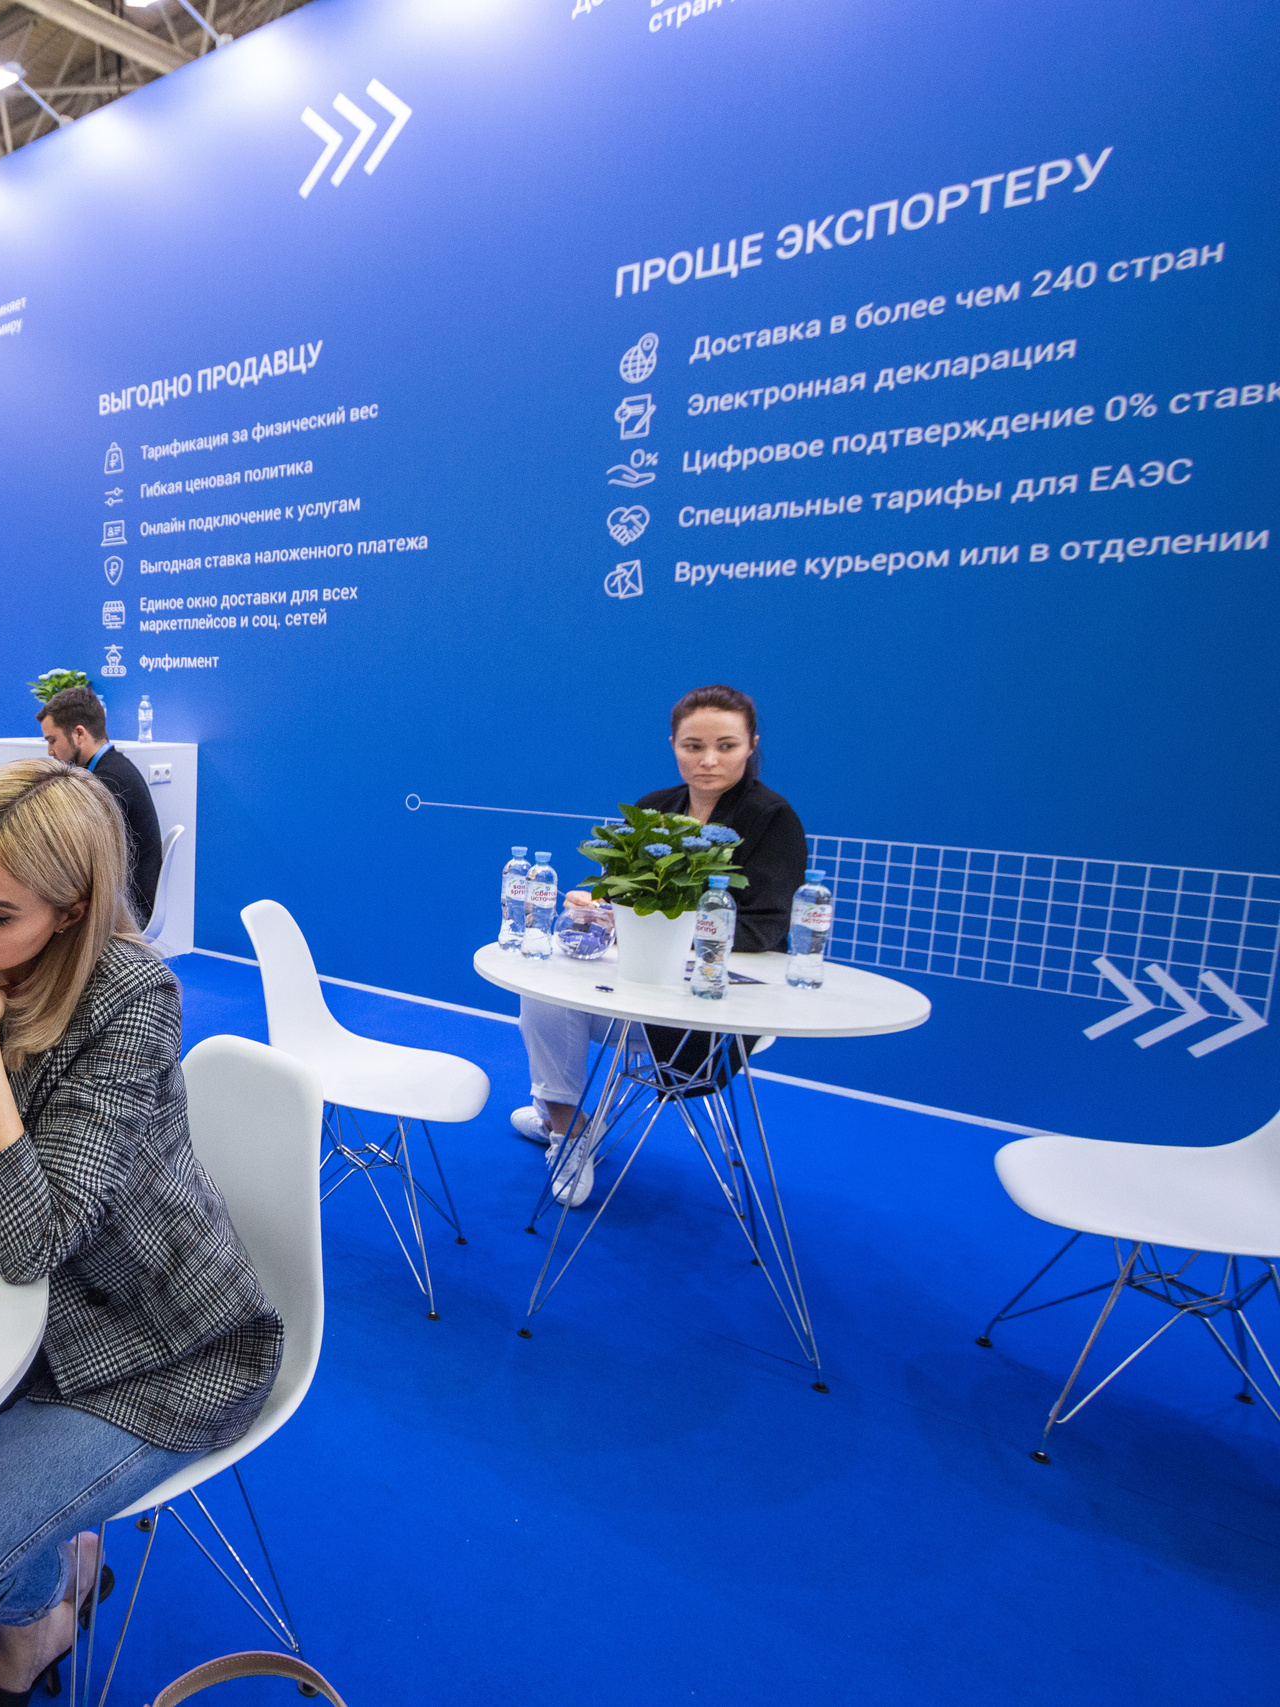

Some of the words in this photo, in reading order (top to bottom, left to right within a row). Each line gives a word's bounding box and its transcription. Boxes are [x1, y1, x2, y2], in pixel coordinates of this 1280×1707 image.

[615, 232, 764, 298] ПРОЩЕ
[776, 146, 1114, 260] ЭКСПОРТЕРУ
[689, 319, 821, 365] Доставка
[830, 314, 847, 334] в
[855, 295, 947, 329] более
[956, 281, 1021, 309] чем
[1031, 261, 1098, 297] 240
[1107, 242, 1225, 282] стран
[99, 373, 192, 416] ВЫГОДНО
[197, 340, 323, 393] ПРОДАВЦУ
[687, 372, 866, 416] Электронная
[873, 339, 1077, 393] декларация
[140, 432, 229, 461] Тарификация
[232, 429, 248, 444] за
[251, 406, 346, 443] физический
[350, 403, 379, 422] вес
[682, 439, 825, 475] Цифровое
[832, 405, 1095, 455] подтверждение
[1105, 393, 1158, 422] 0%
[140, 481, 183, 498] Гибкая
[185, 471, 241, 494] ценовая
[244, 460, 313, 483] политика
[678, 494, 863, 528] Специальные
[871, 478, 1002, 514] тарифы
[1010, 474, 1078, 504] для
[1089, 458, 1193, 492] ЕАЭС
[140, 517, 186, 537] Онлайн
[188, 507, 282, 532] подключение
[285, 506, 294, 519] к
[297, 497, 361, 522] услугам
[140, 557, 202, 574] Выгодная
[204, 552, 251, 568] ставка
[255, 543, 353, 564] наложенного
[357, 535, 428, 555] платежа
[674, 558, 798, 586] Вручение
[804, 549, 950, 580] курьером
[959, 545, 1019, 566] или
[1029, 543, 1050, 562] в
[1060, 530, 1269, 564] отделении
[140, 597, 184, 614] Единое
[186, 595, 218, 609] окно
[220, 591, 287, 610] доставки
[290, 589, 318, 606] для
[322, 586, 358, 601] всех
[140, 614, 237, 634] маркетплейсов
[240, 616, 249, 628] и
[252, 614, 281, 629] соц.
[285, 608, 327, 626] сетей
[139, 653, 219, 672] Фулфилмент
